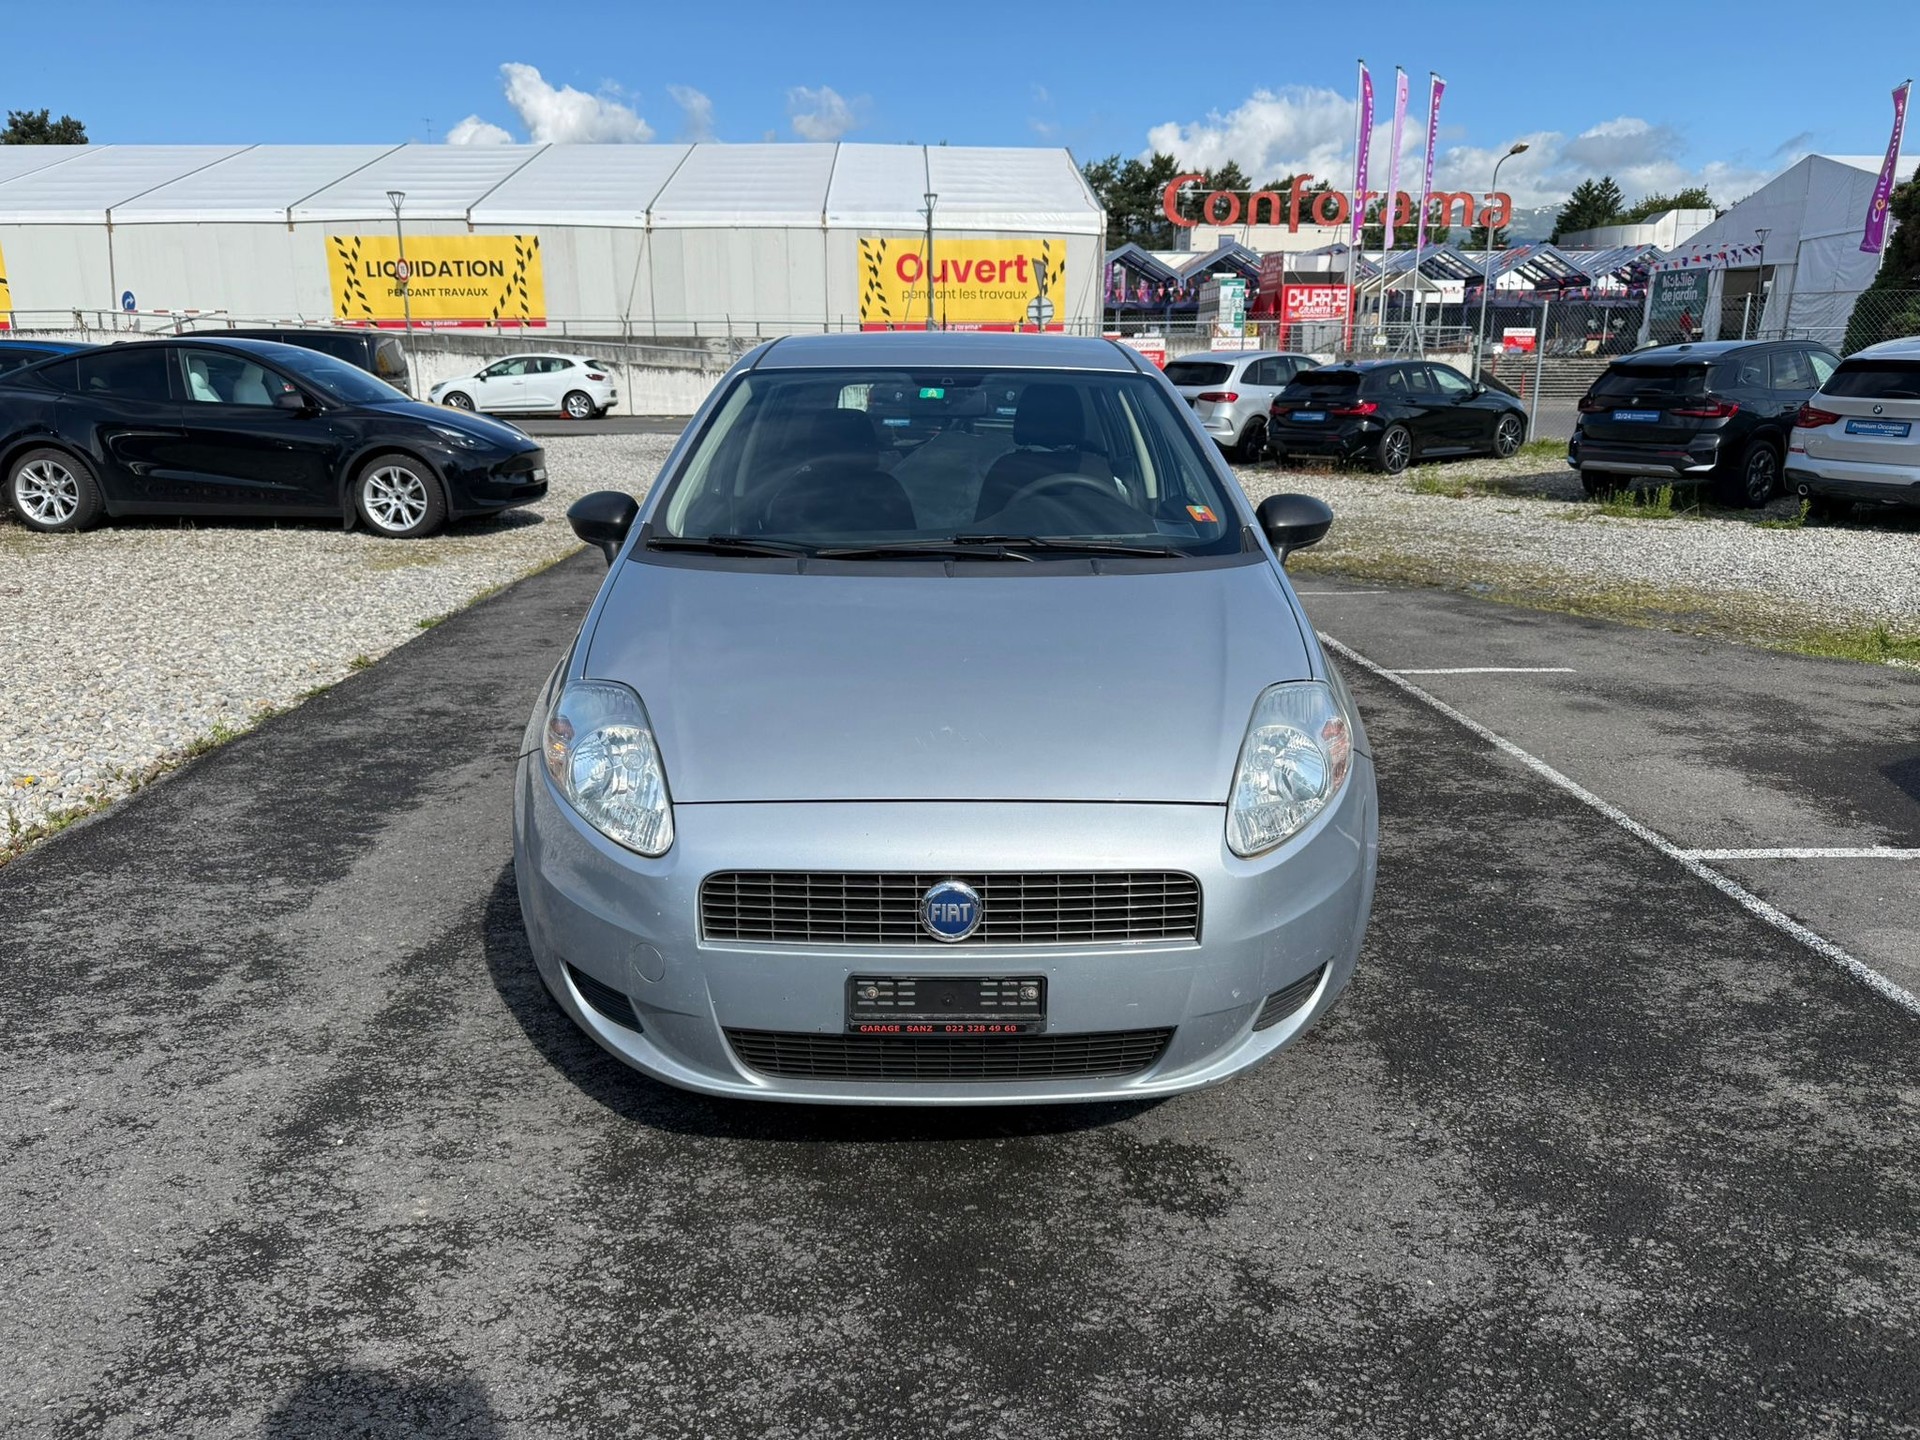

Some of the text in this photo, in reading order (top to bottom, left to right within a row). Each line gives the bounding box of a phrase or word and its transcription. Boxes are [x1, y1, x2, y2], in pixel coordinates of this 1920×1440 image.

[1163, 174, 1512, 232] Conforama
[366, 260, 504, 279] LIQUIDATION
[896, 253, 1028, 283] Ouvert
[387, 288, 488, 297] PENDANT TRAVAUX
[959, 288, 976, 299] les
[979, 289, 1028, 299] travaux
[1288, 289, 1348, 306] CHURROS
[1662, 287, 1698, 305] de jardin
[1216, 339, 1255, 347] Conforma
[1615, 412, 1632, 420] 12/24
[931, 903, 971, 922] FIAT
